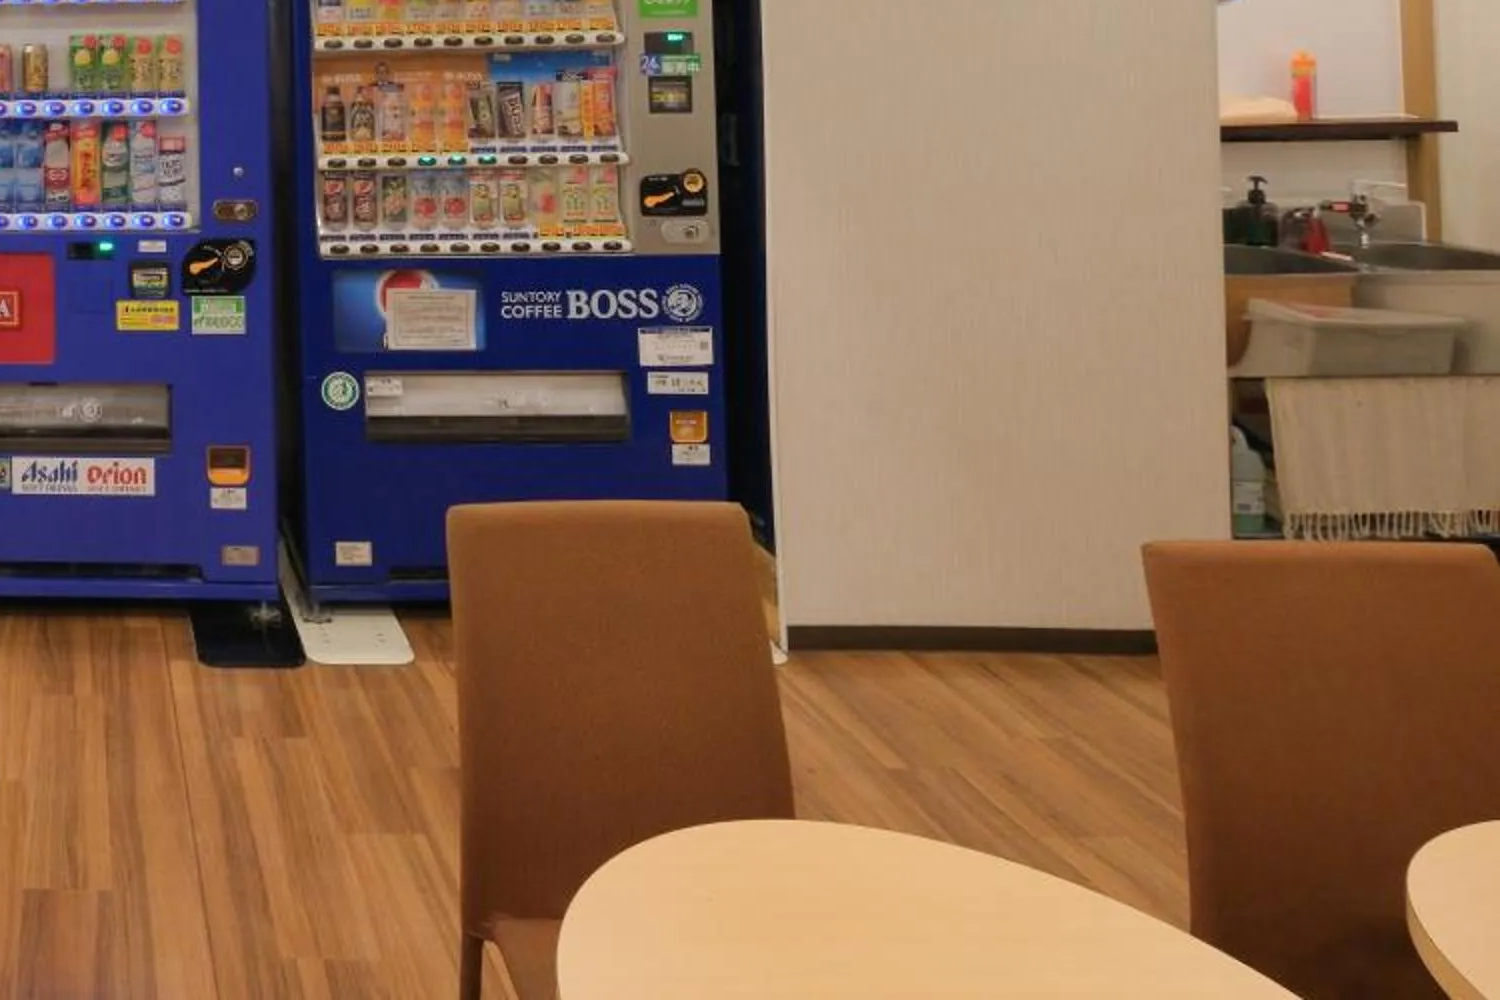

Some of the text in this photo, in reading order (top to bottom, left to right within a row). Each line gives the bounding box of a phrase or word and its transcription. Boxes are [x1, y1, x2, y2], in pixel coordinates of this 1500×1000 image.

[501, 291, 562, 303] SUNTORY
[567, 289, 659, 319] BOSS
[501, 305, 562, 319] COFFEE
[21, 459, 147, 485] Asahi Orion
